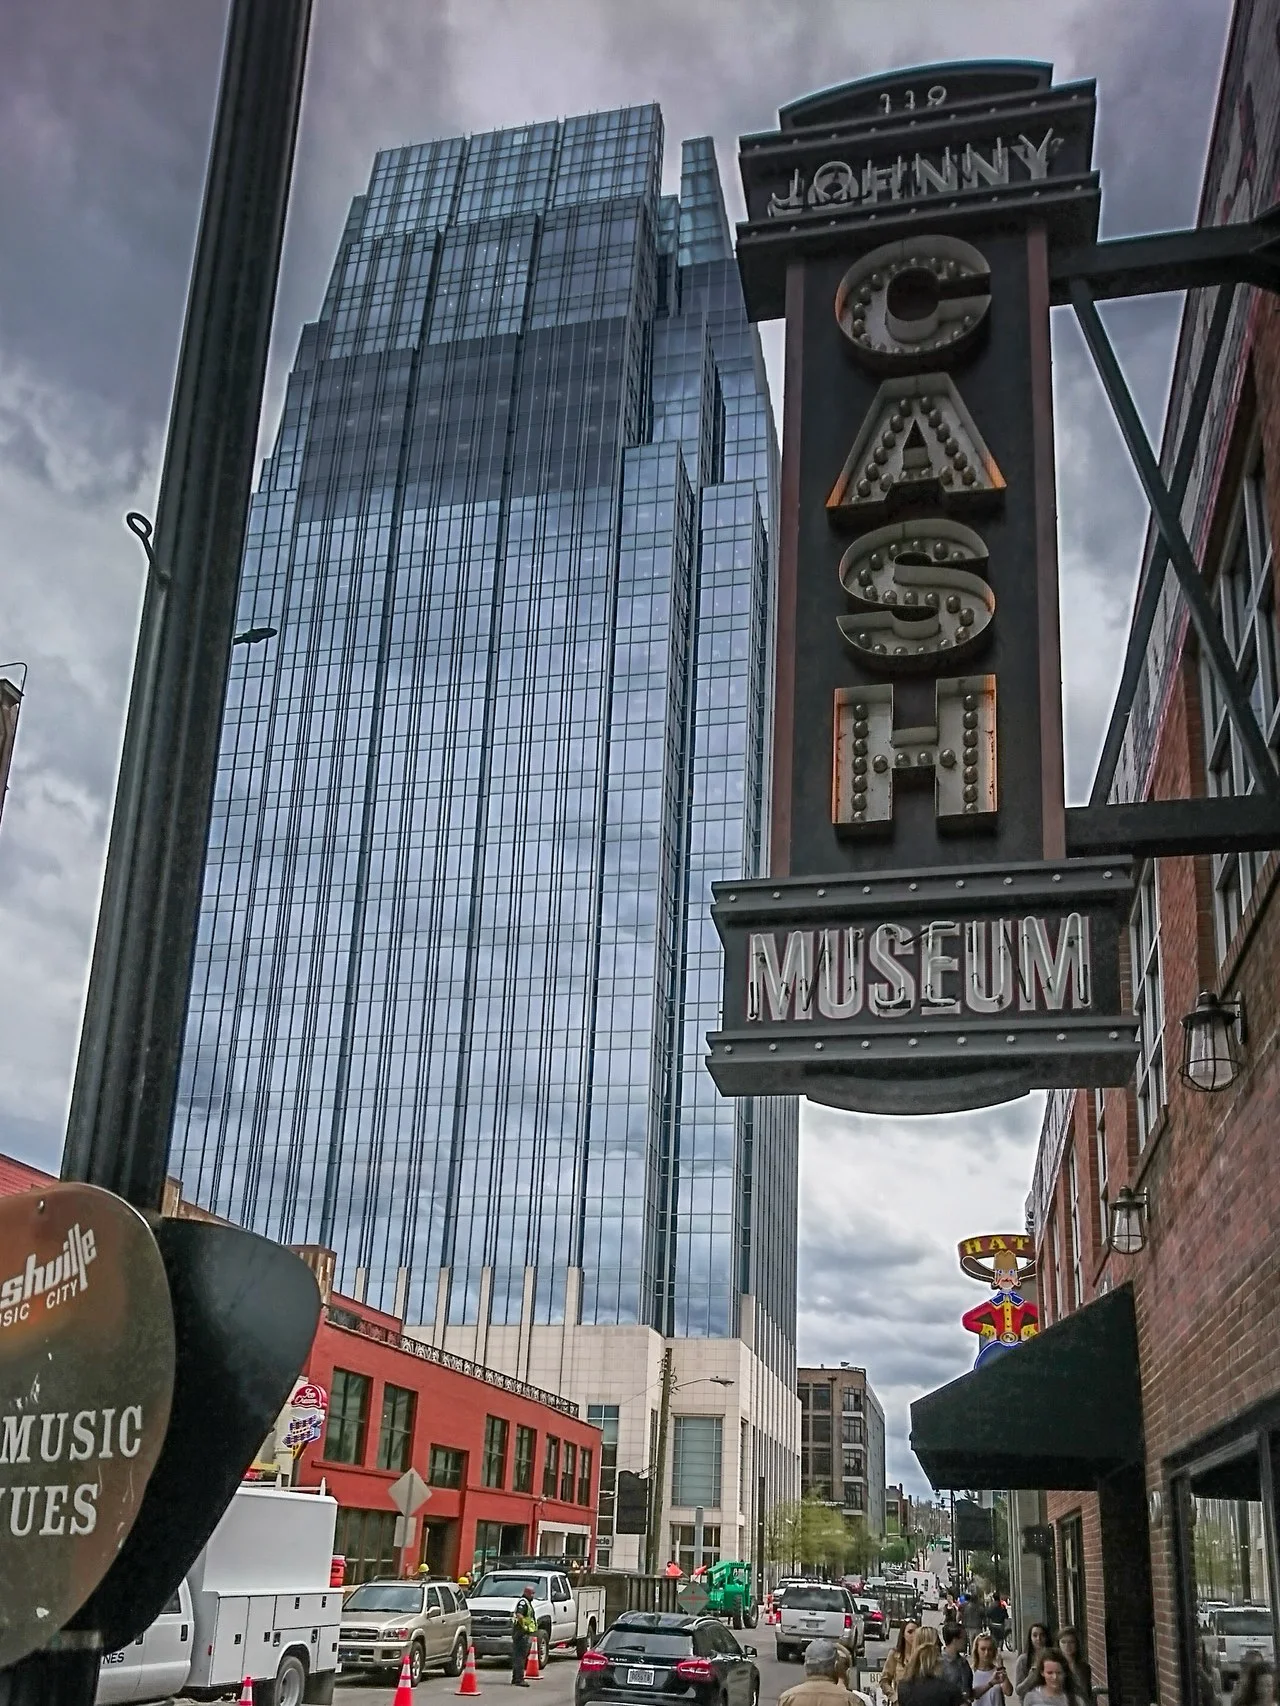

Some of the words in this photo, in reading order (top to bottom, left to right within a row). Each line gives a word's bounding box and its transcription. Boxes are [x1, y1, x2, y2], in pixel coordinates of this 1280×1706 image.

[880, 86, 948, 115] 119
[767, 128, 1063, 217] JOHNNY
[826, 234, 1008, 830] CASH
[746, 912, 1093, 1022] MUSEUM
[964, 1236, 1030, 1254] HAT
[0, 1303, 30, 1327] SIC
[46, 1279, 78, 1309] CITY
[0, 1405, 142, 1464] MUSIC
[0, 1483, 98, 1537] UES
